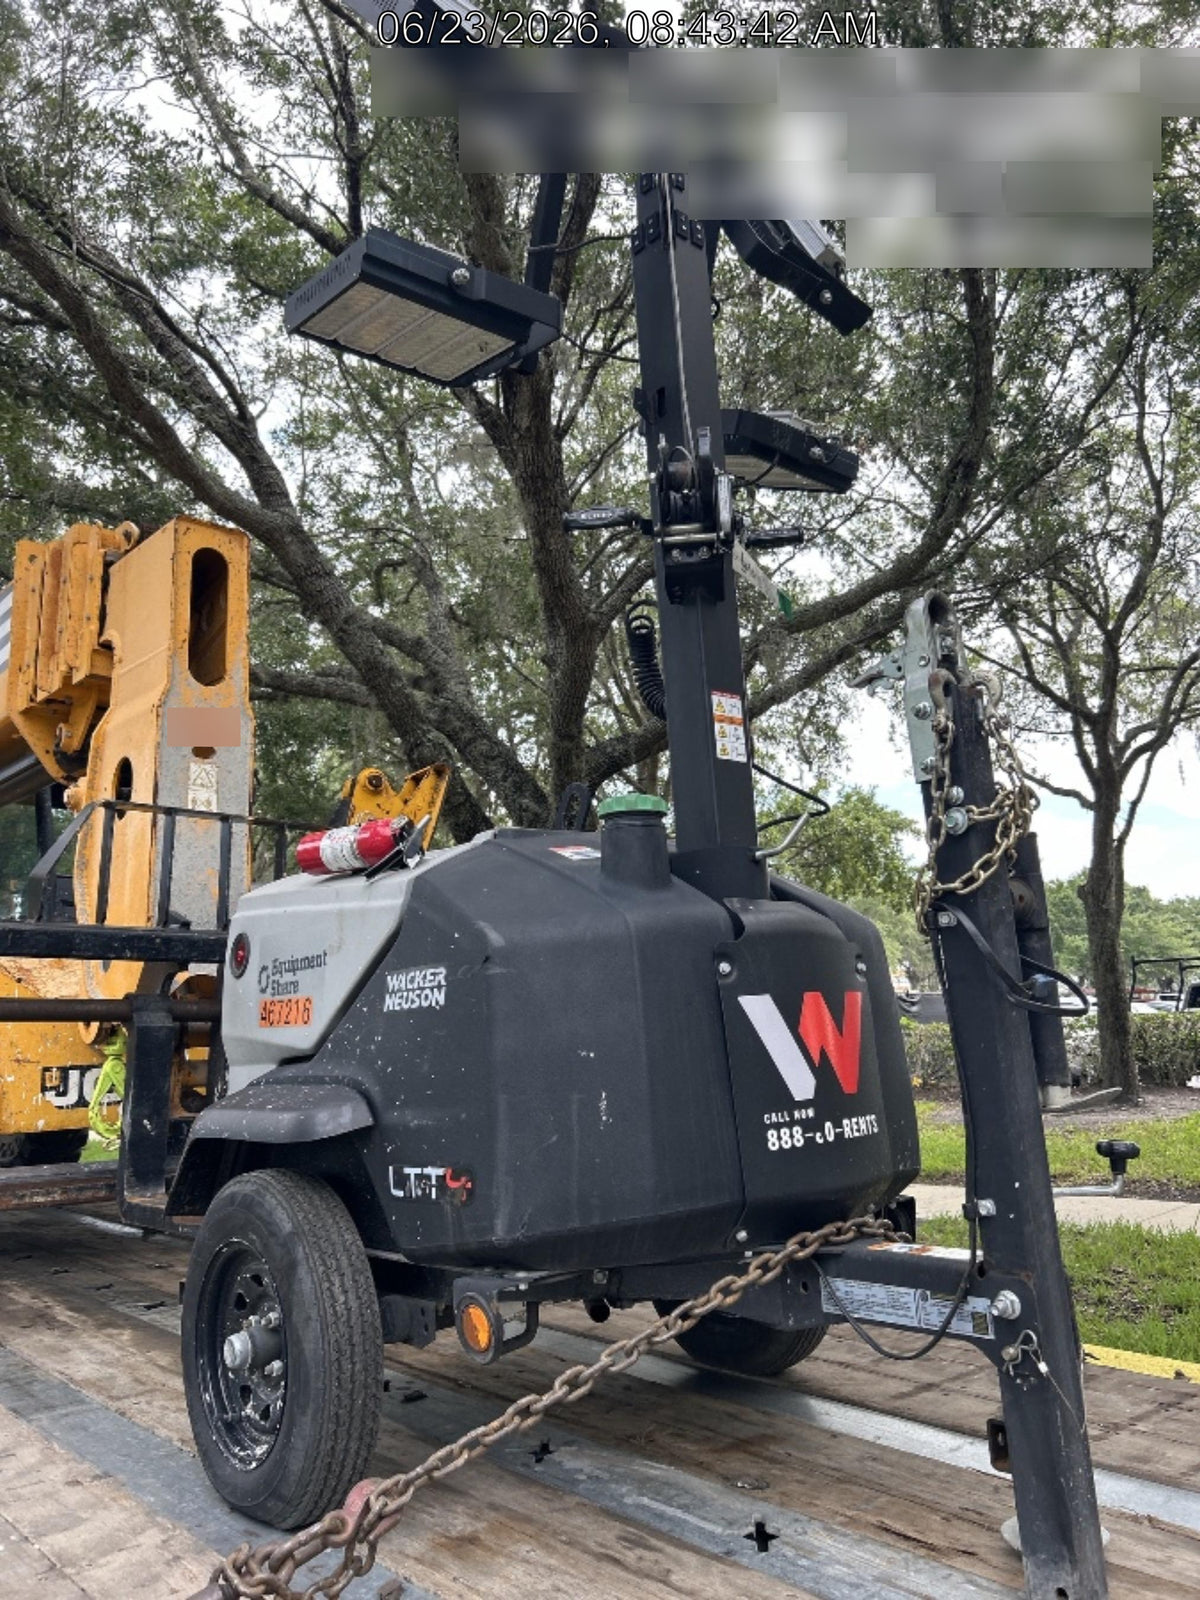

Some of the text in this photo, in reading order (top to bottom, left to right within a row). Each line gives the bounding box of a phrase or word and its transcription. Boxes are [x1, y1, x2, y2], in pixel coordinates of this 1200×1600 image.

[271, 950, 328, 978] Equipment
[271, 979, 300, 997] Share
[383, 986, 446, 1012] NEUSON
[260, 996, 312, 1026] 467216
[763, 1106, 816, 1125] CALL NOW
